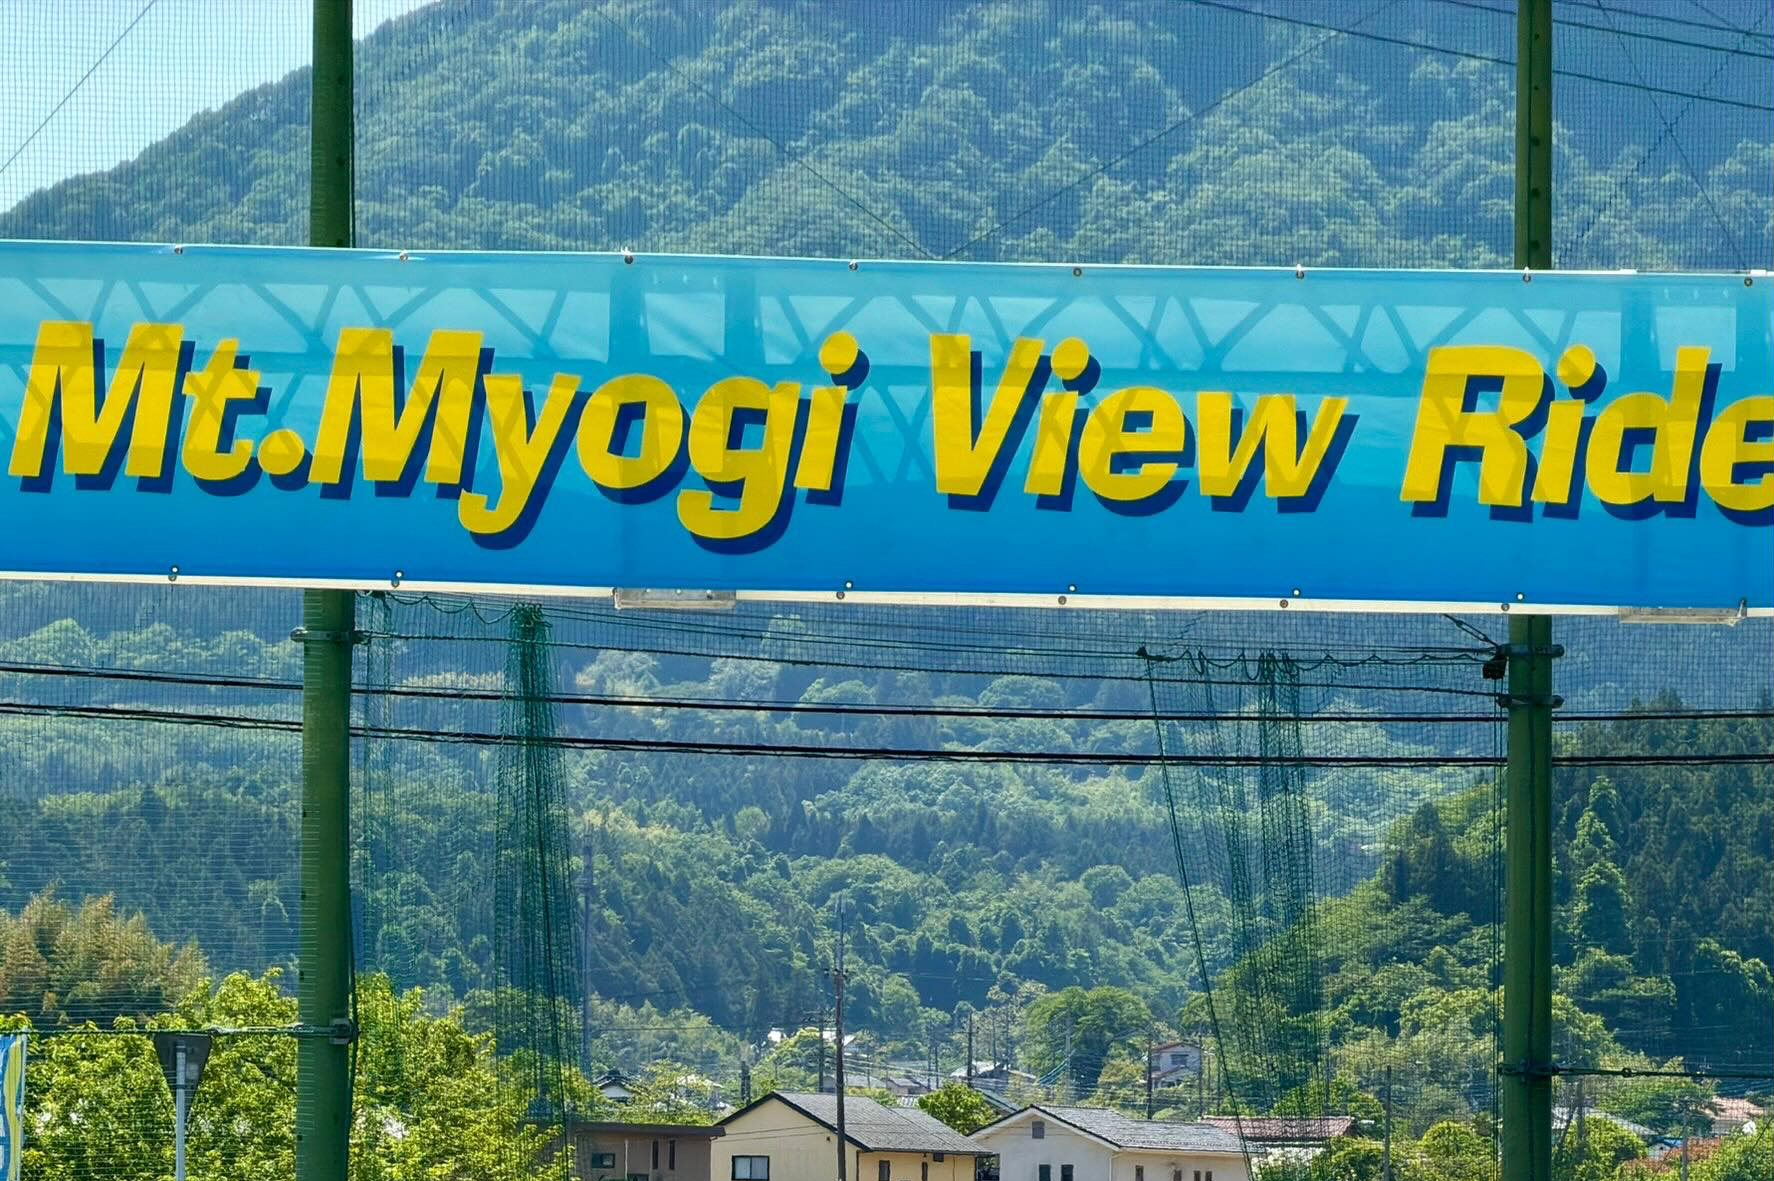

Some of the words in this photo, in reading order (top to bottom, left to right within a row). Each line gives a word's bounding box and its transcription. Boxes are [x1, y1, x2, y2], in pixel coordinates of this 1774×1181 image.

[10, 321, 866, 548] Mt.Myogi
[929, 332, 1354, 512] View
[1400, 344, 1774, 524] Ride
